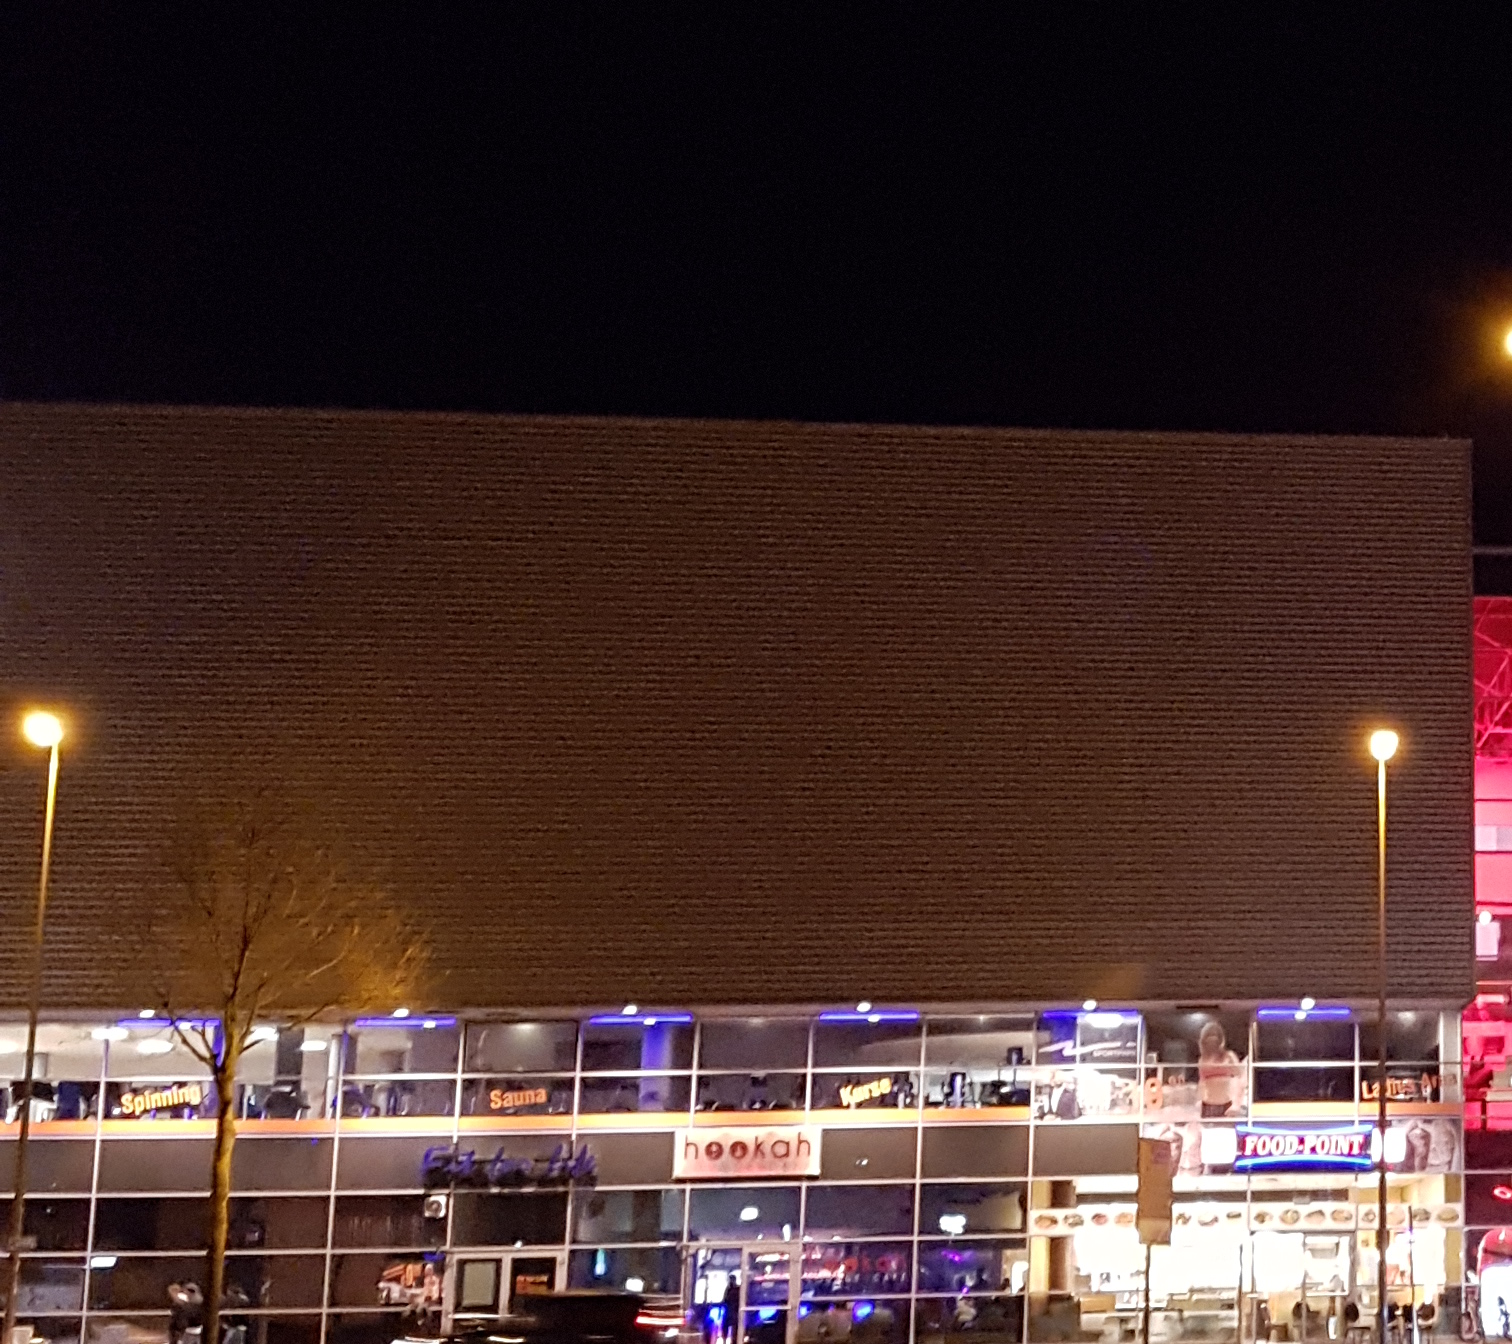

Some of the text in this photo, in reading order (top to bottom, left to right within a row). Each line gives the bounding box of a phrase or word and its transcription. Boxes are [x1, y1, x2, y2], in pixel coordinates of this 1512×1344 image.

[120, 1085, 201, 1116] Spinning
[490, 1088, 547, 1109] Sauna
[1244, 1134, 1366, 1156] FOOD-POINT
